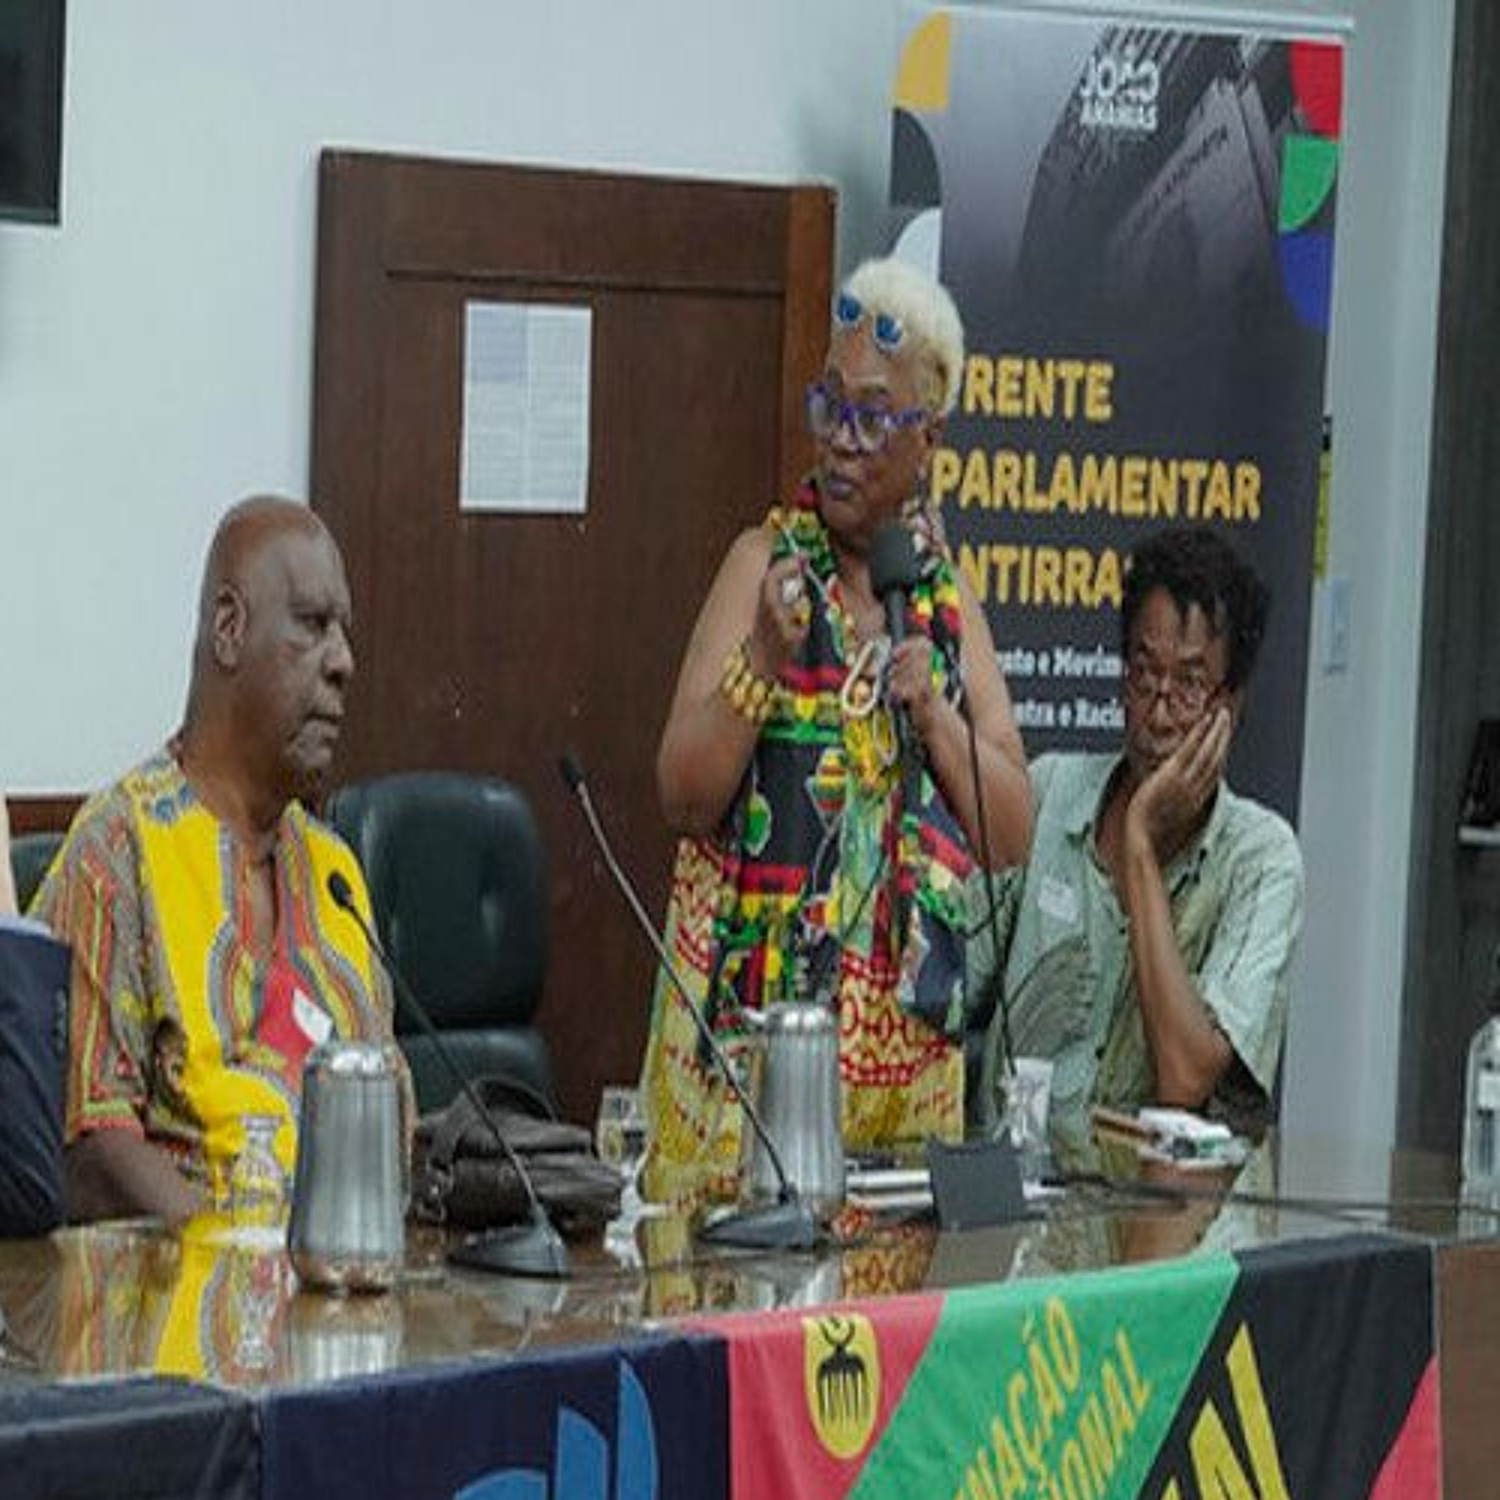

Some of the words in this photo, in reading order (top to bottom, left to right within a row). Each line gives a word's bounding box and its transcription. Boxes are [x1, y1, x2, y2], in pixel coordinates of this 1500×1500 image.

[963, 355, 1114, 421] RENTE
[931, 447, 1261, 522] PARLAMENTAR
[957, 541, 1134, 609] NTIRRA
